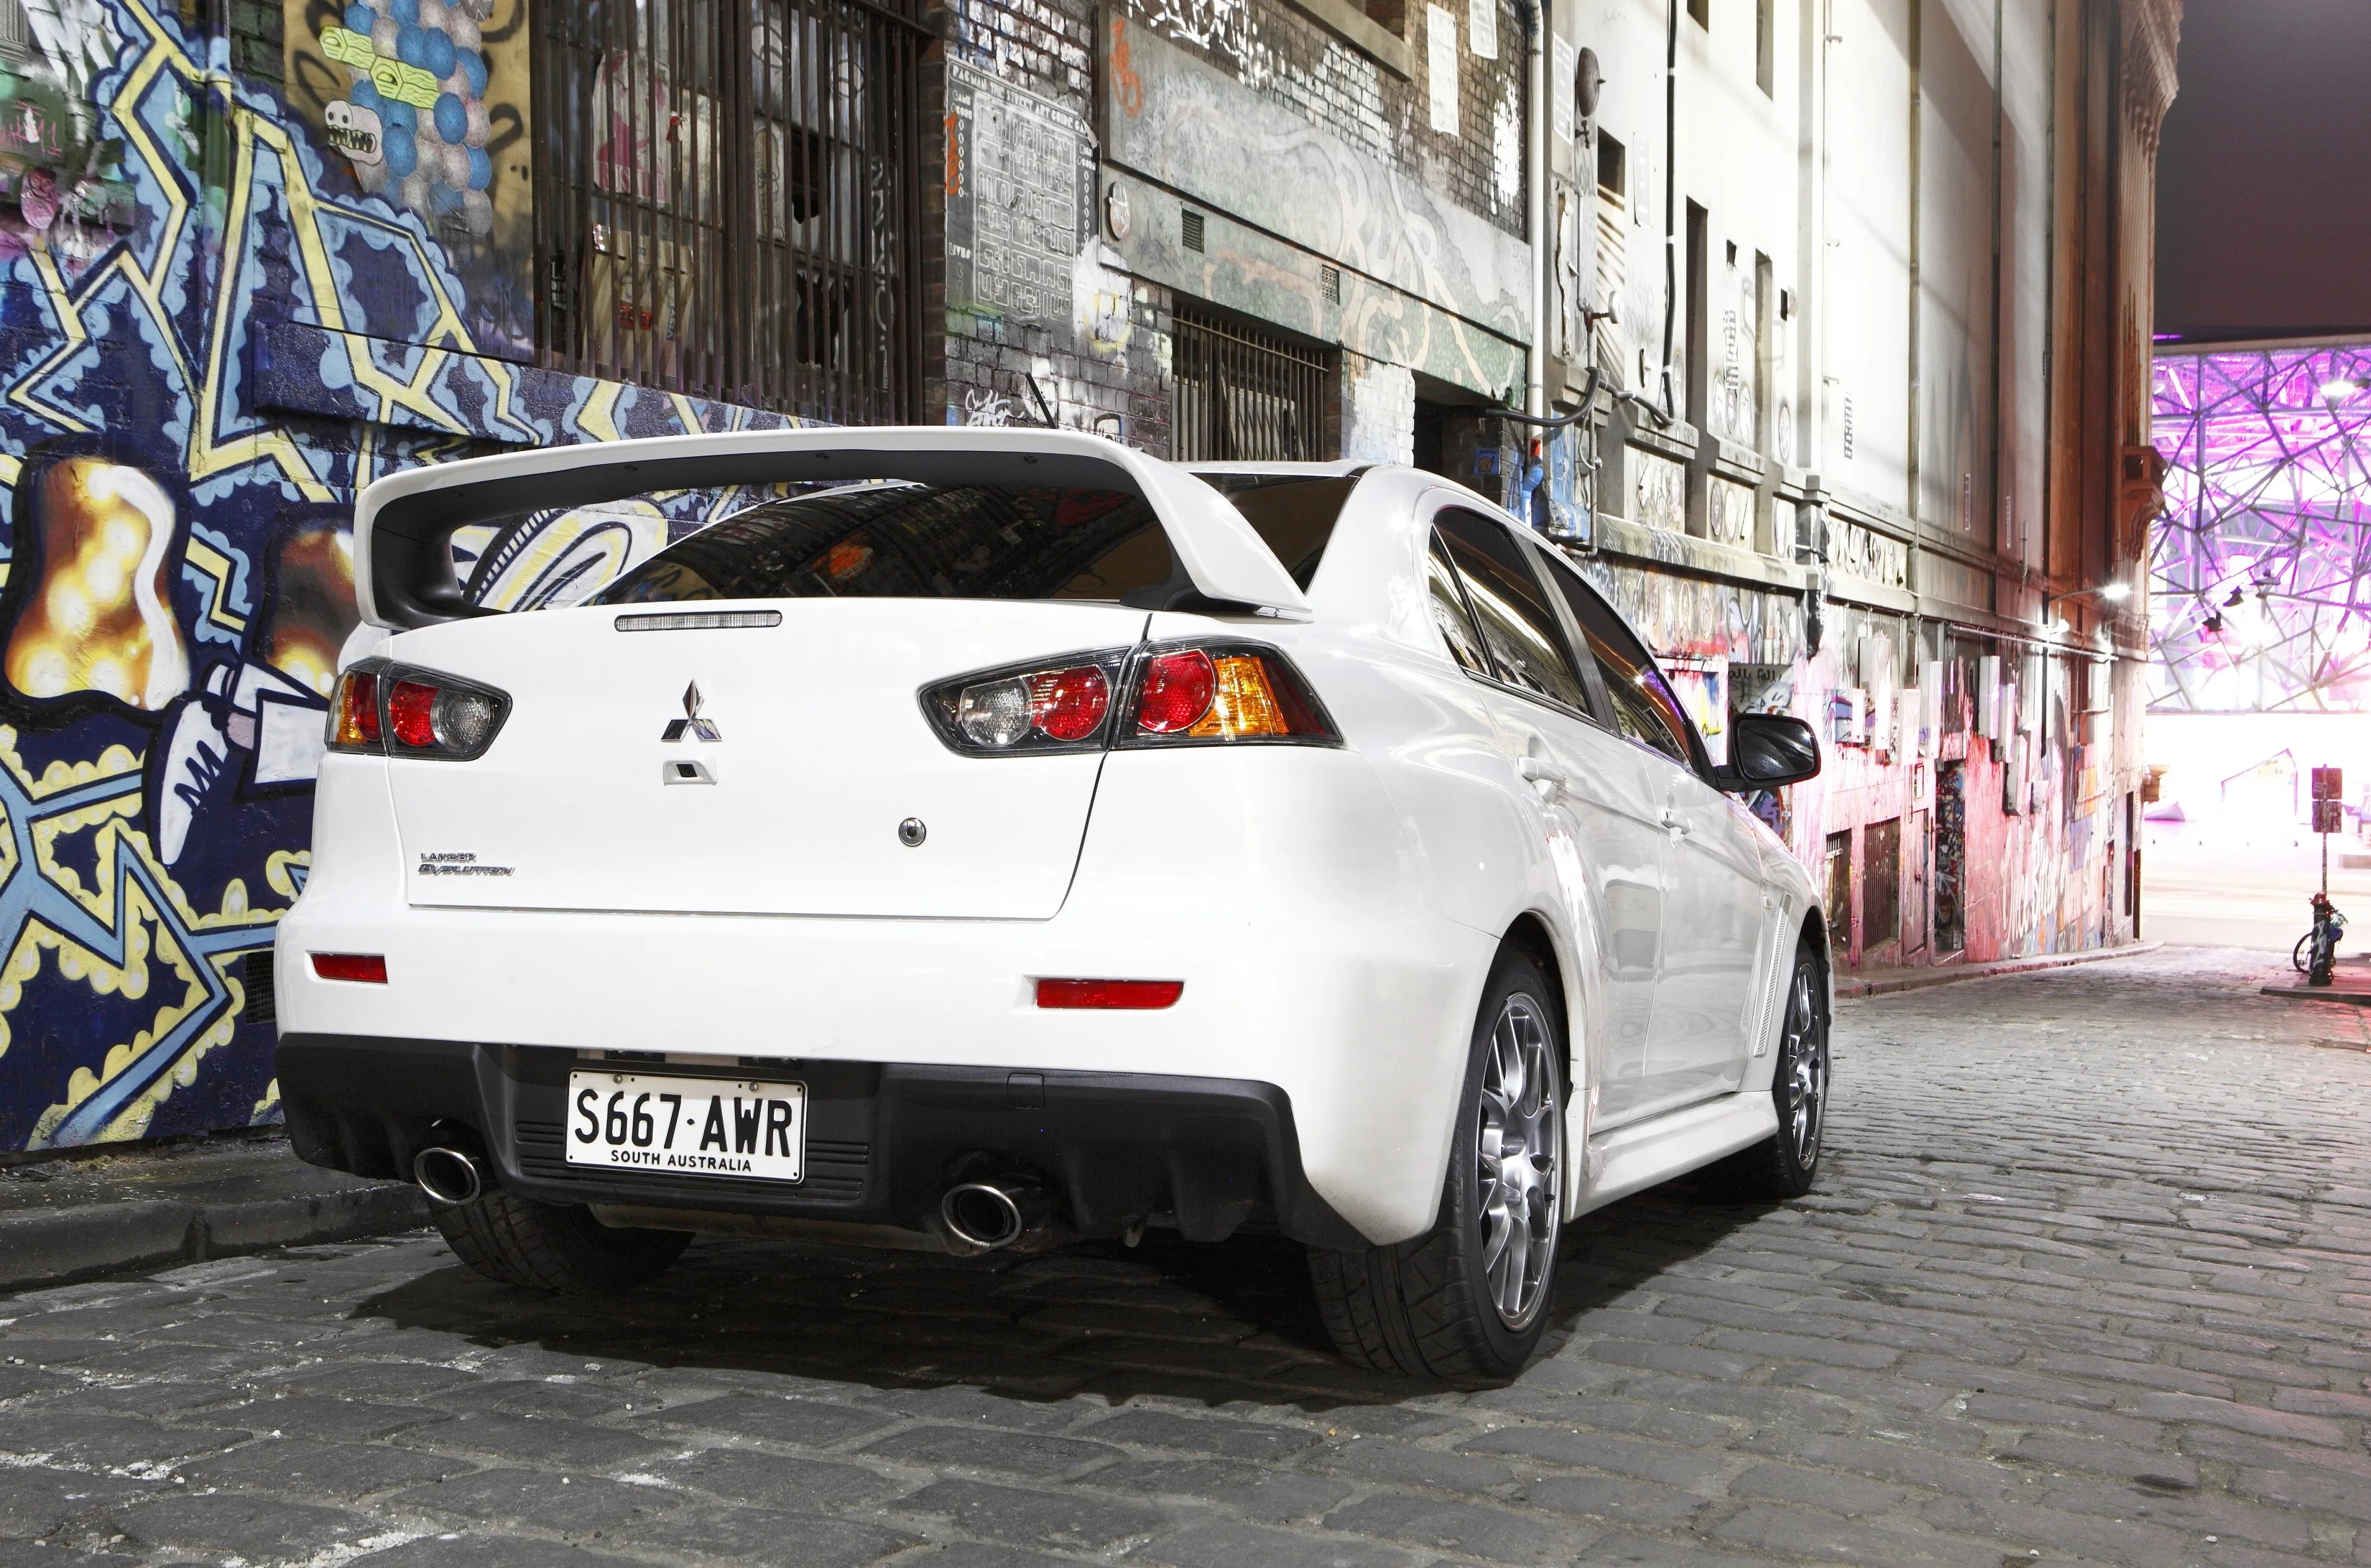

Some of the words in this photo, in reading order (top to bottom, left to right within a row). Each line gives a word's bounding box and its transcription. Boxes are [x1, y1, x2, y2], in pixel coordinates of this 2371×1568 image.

[952, 64, 986, 91] PACMAN
[989, 83, 1004, 99] THE
[1007, 90, 1034, 111] STREET
[1035, 103, 1050, 119] ART
[1050, 109, 1073, 127] GUIDE
[949, 242, 971, 259] LIVES
[420, 853, 477, 863] LANCER
[418, 863, 515, 876] EVOLUTION
[611, 1150, 660, 1165] SOUTH
[667, 1155, 752, 1172] AUSTRALIA
